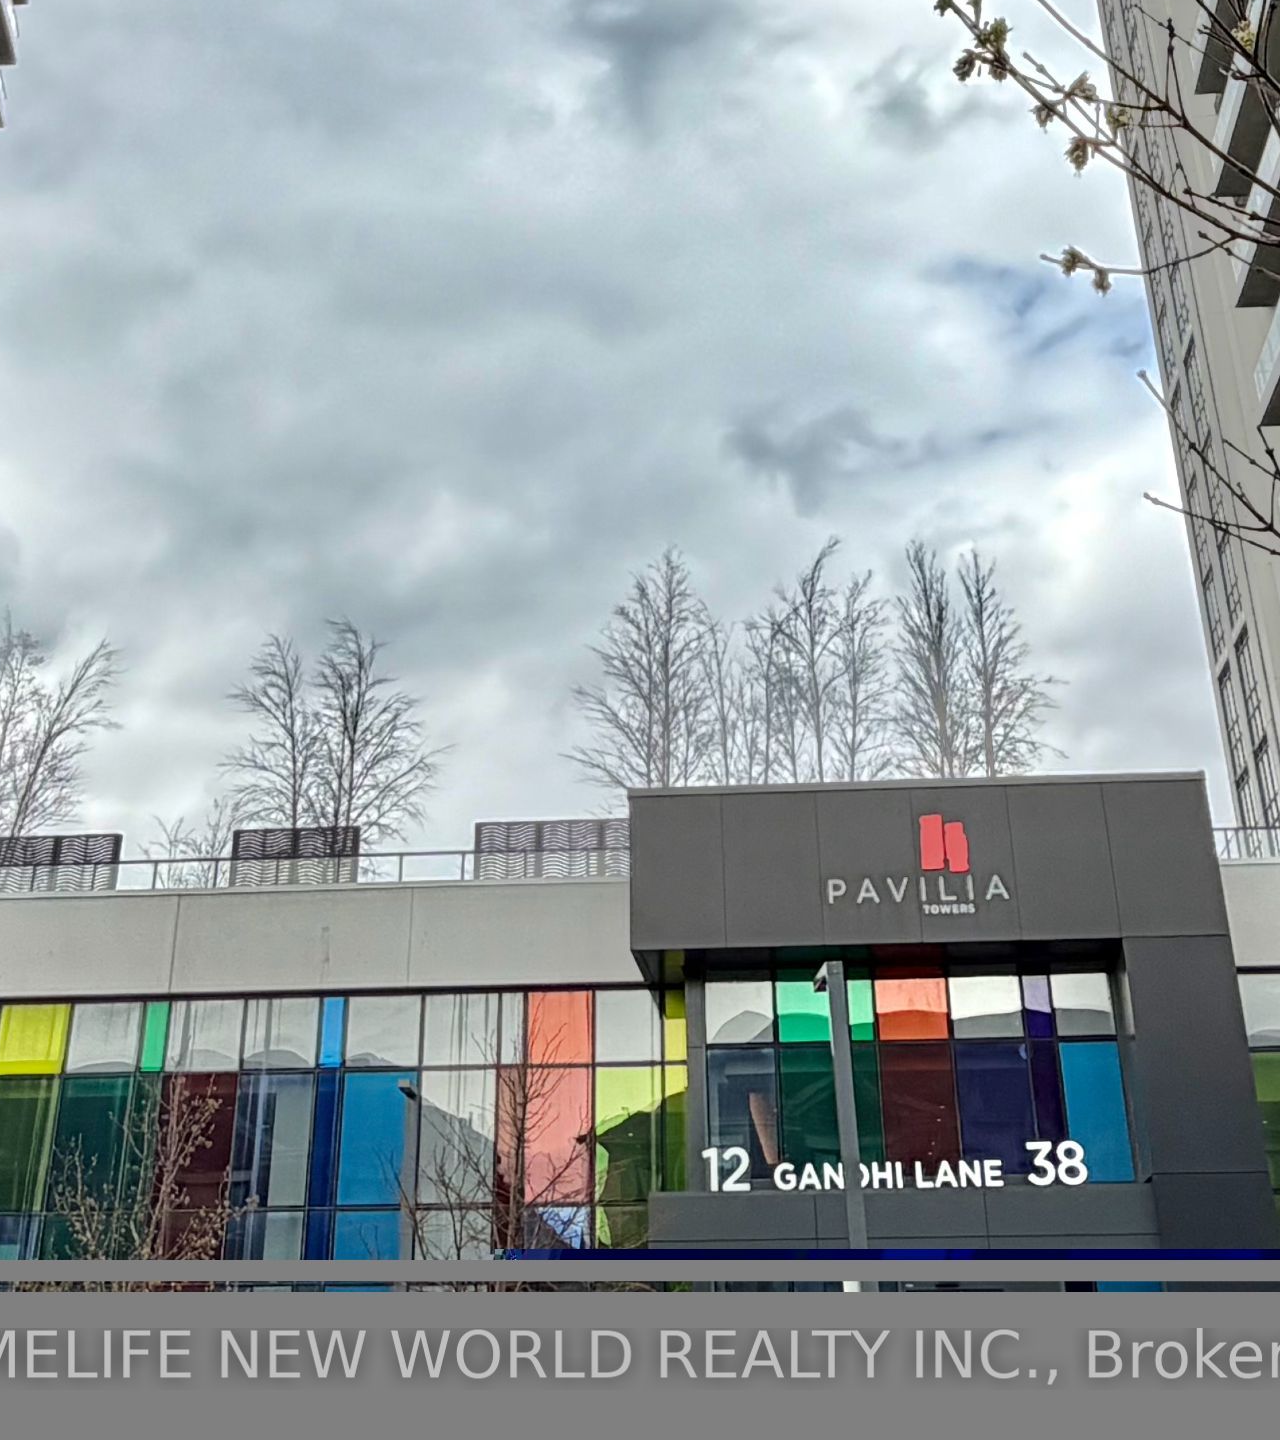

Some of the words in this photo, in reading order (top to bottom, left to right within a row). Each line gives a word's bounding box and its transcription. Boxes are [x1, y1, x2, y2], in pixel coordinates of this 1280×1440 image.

[826, 874, 1011, 905] PAVILIA
[922, 903, 976, 915] TOWERS
[701, 1146, 752, 1193] 12
[914, 1159, 1006, 1189] LANE
[1024, 1140, 1089, 1187] 38
